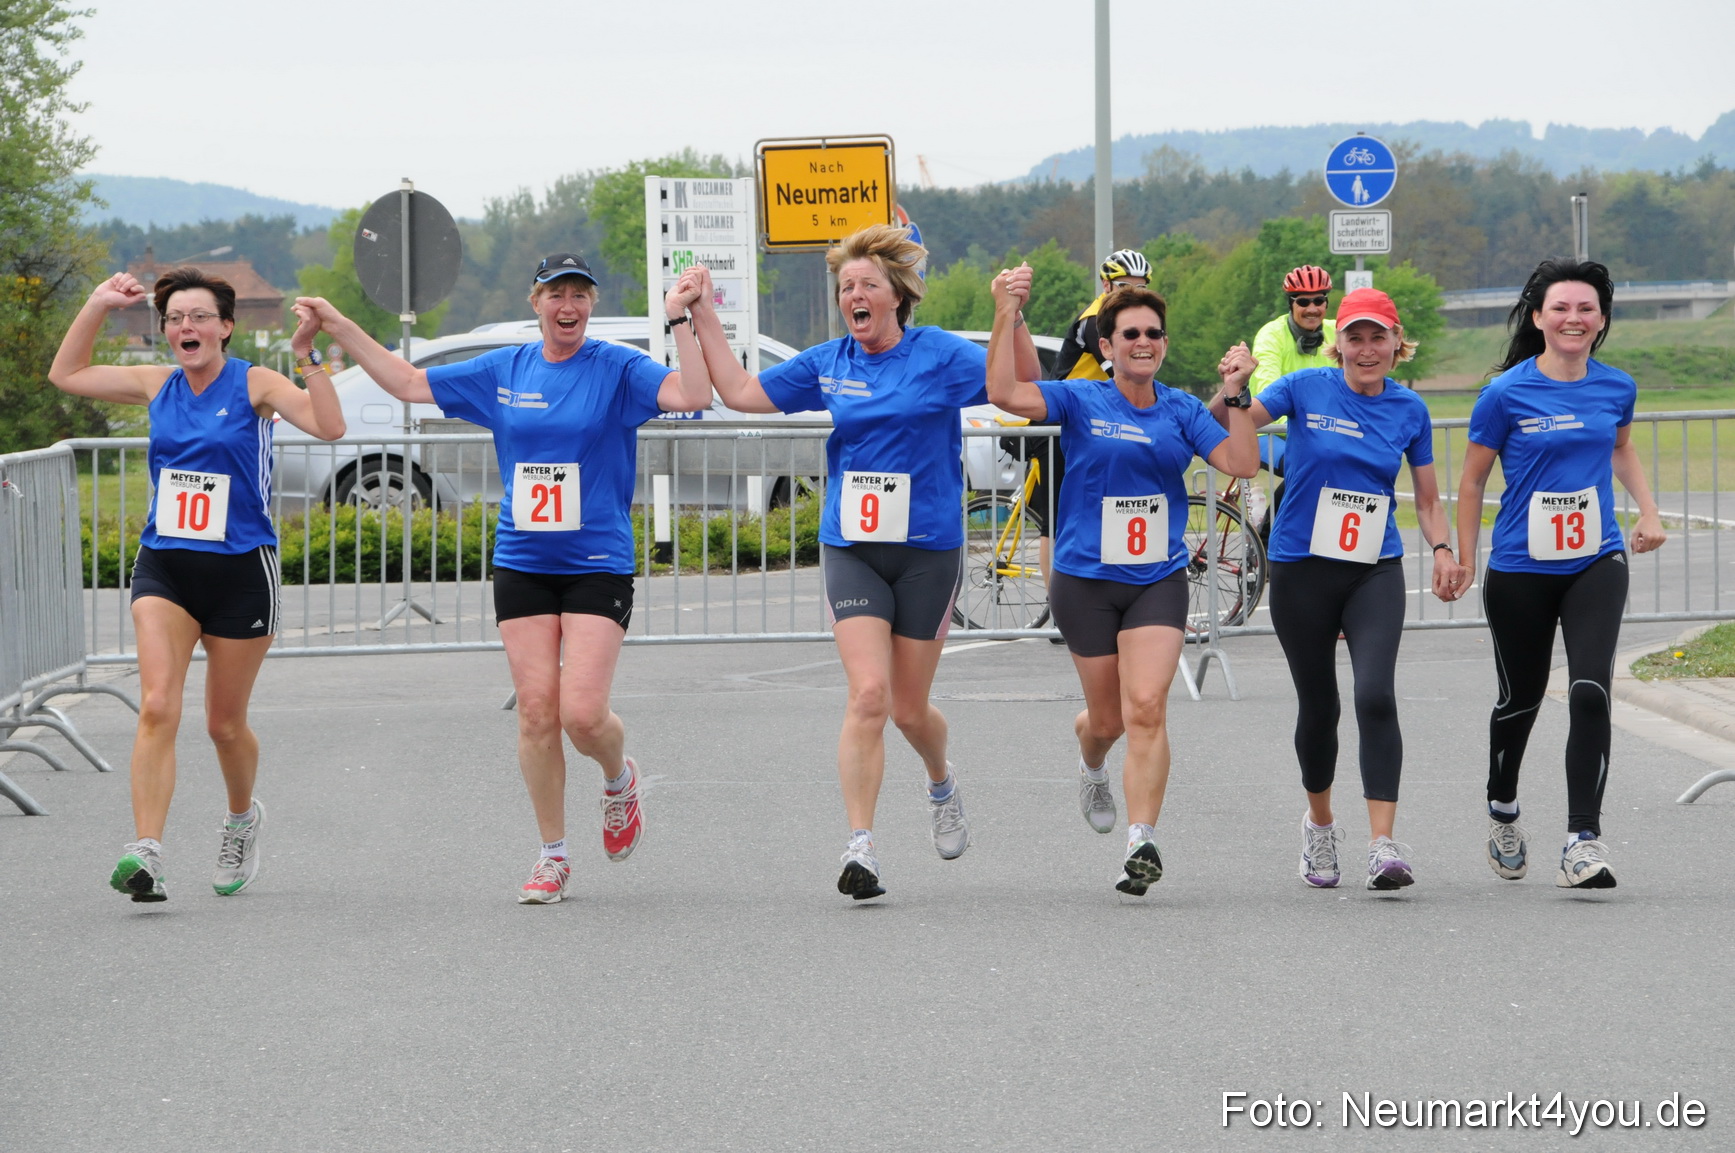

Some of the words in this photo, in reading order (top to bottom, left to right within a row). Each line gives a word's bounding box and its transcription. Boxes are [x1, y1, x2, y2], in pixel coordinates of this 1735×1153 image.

[809, 161, 844, 173] Nach
[692, 182, 733, 196] HOLZAMMER
[776, 180, 878, 206] Neumarkt
[693, 215, 734, 229] HOLZAMMER
[812, 214, 819, 226] 5
[830, 215, 847, 226] km
[1341, 216, 1380, 226] Landwirt-
[1337, 227, 1384, 237] schaftlicher
[1337, 238, 1367, 247] Verkehr
[1371, 238, 1384, 247] frei
[522, 466, 551, 474] MEYER
[170, 473, 201, 483] MEYER
[852, 475, 881, 484] MEYER
[170, 481, 201, 489] WERBUNG
[531, 483, 562, 522] 21
[1115, 500, 1148, 508] MEYER
[1332, 492, 1365, 504] MEYER
[1542, 497, 1576, 505] MEYER
[176, 491, 210, 531] 10
[1331, 501, 1364, 510] WERBUNG
[860, 493, 879, 533] 9
[1127, 516, 1147, 556] 8
[1339, 512, 1361, 552] 6
[1551, 512, 1585, 551] 13
[835, 598, 869, 610] ODLO
